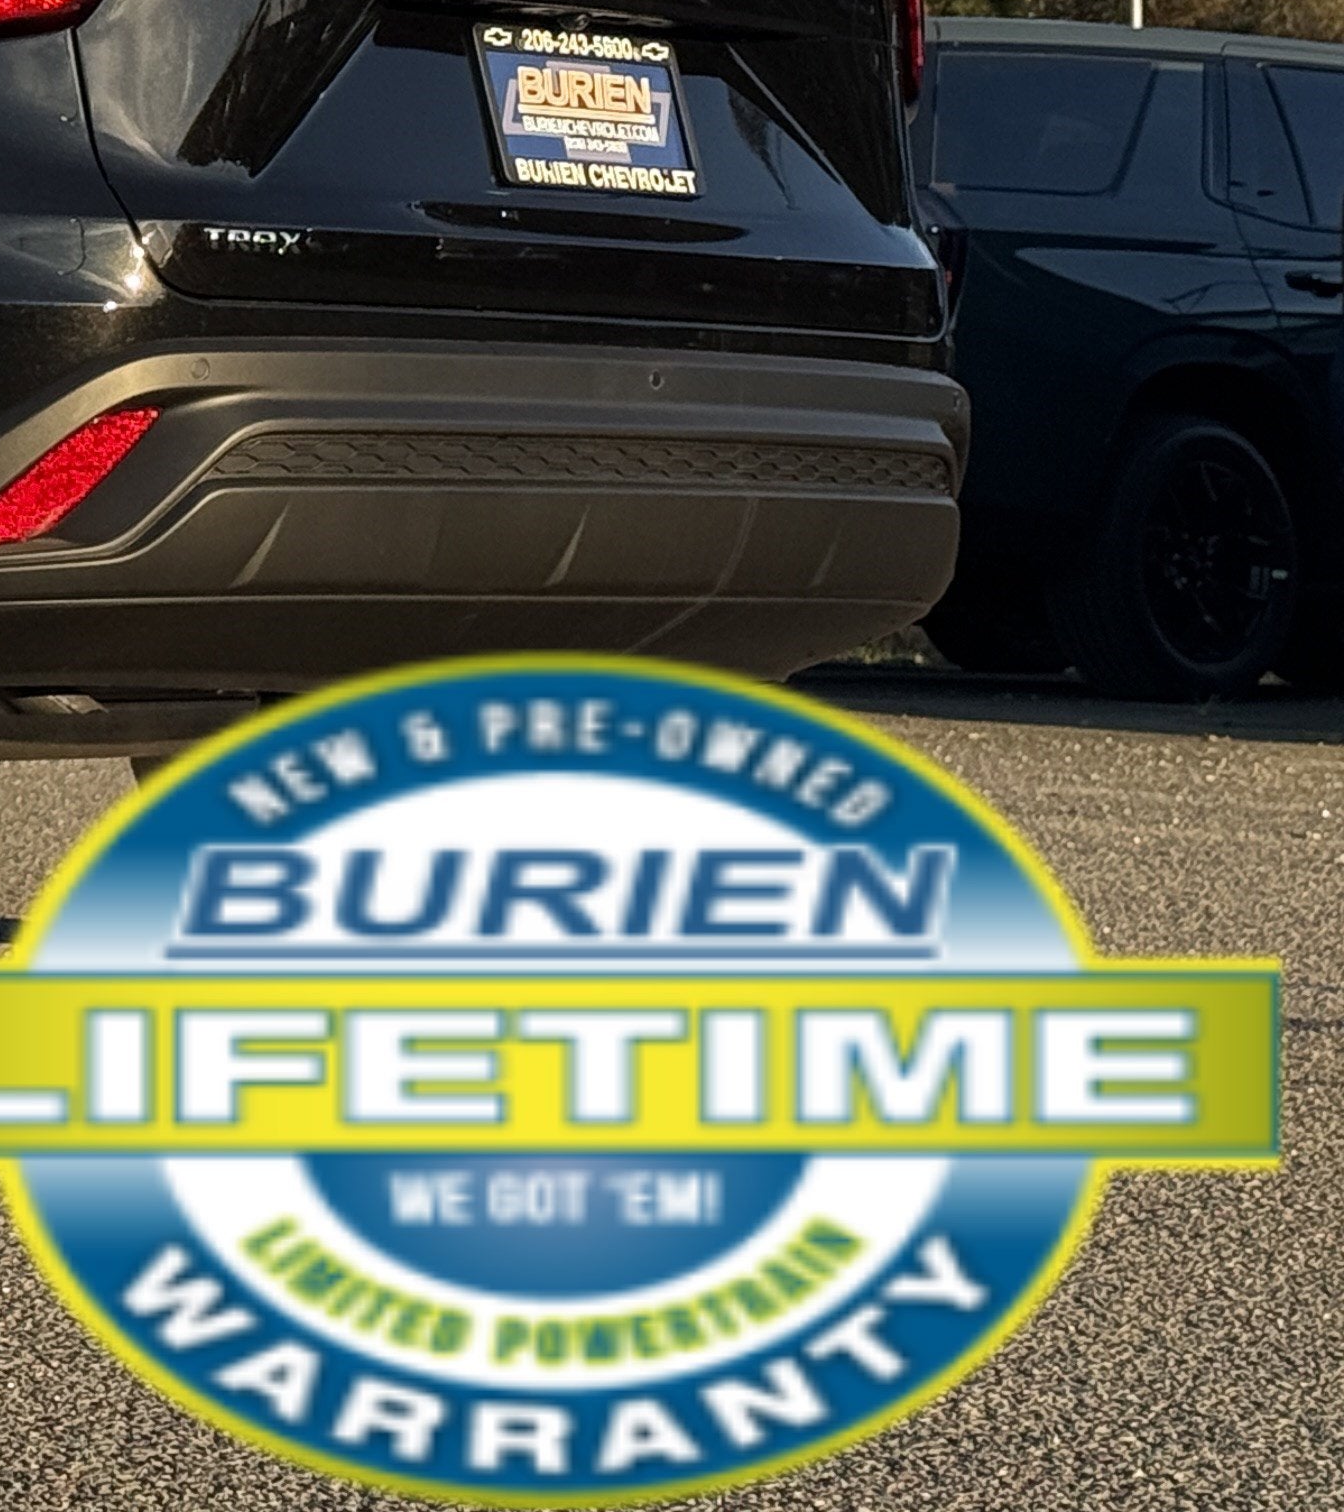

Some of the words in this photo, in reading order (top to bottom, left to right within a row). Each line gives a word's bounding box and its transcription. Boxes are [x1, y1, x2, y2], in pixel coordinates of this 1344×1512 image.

[517, 65, 652, 114] BURIEN
[515, 157, 587, 187] BURIEN
[589, 162, 697, 194] CHEVROLET
